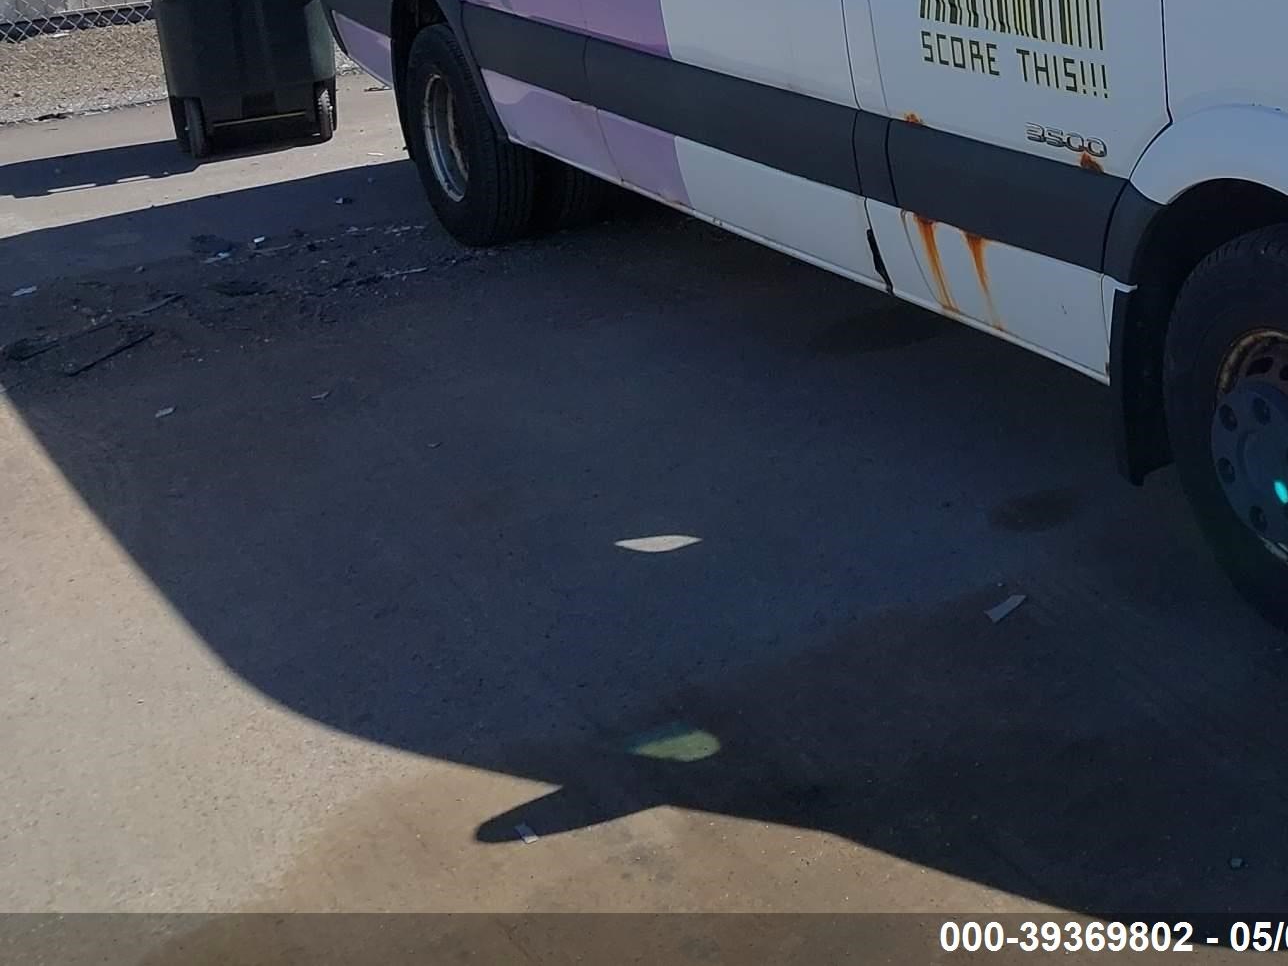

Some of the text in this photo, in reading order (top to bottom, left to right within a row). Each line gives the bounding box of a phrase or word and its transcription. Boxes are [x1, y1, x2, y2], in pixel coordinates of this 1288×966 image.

[920, 30, 1109, 99] SCORE THIS!!!
[1025, 122, 1108, 158] 3500
